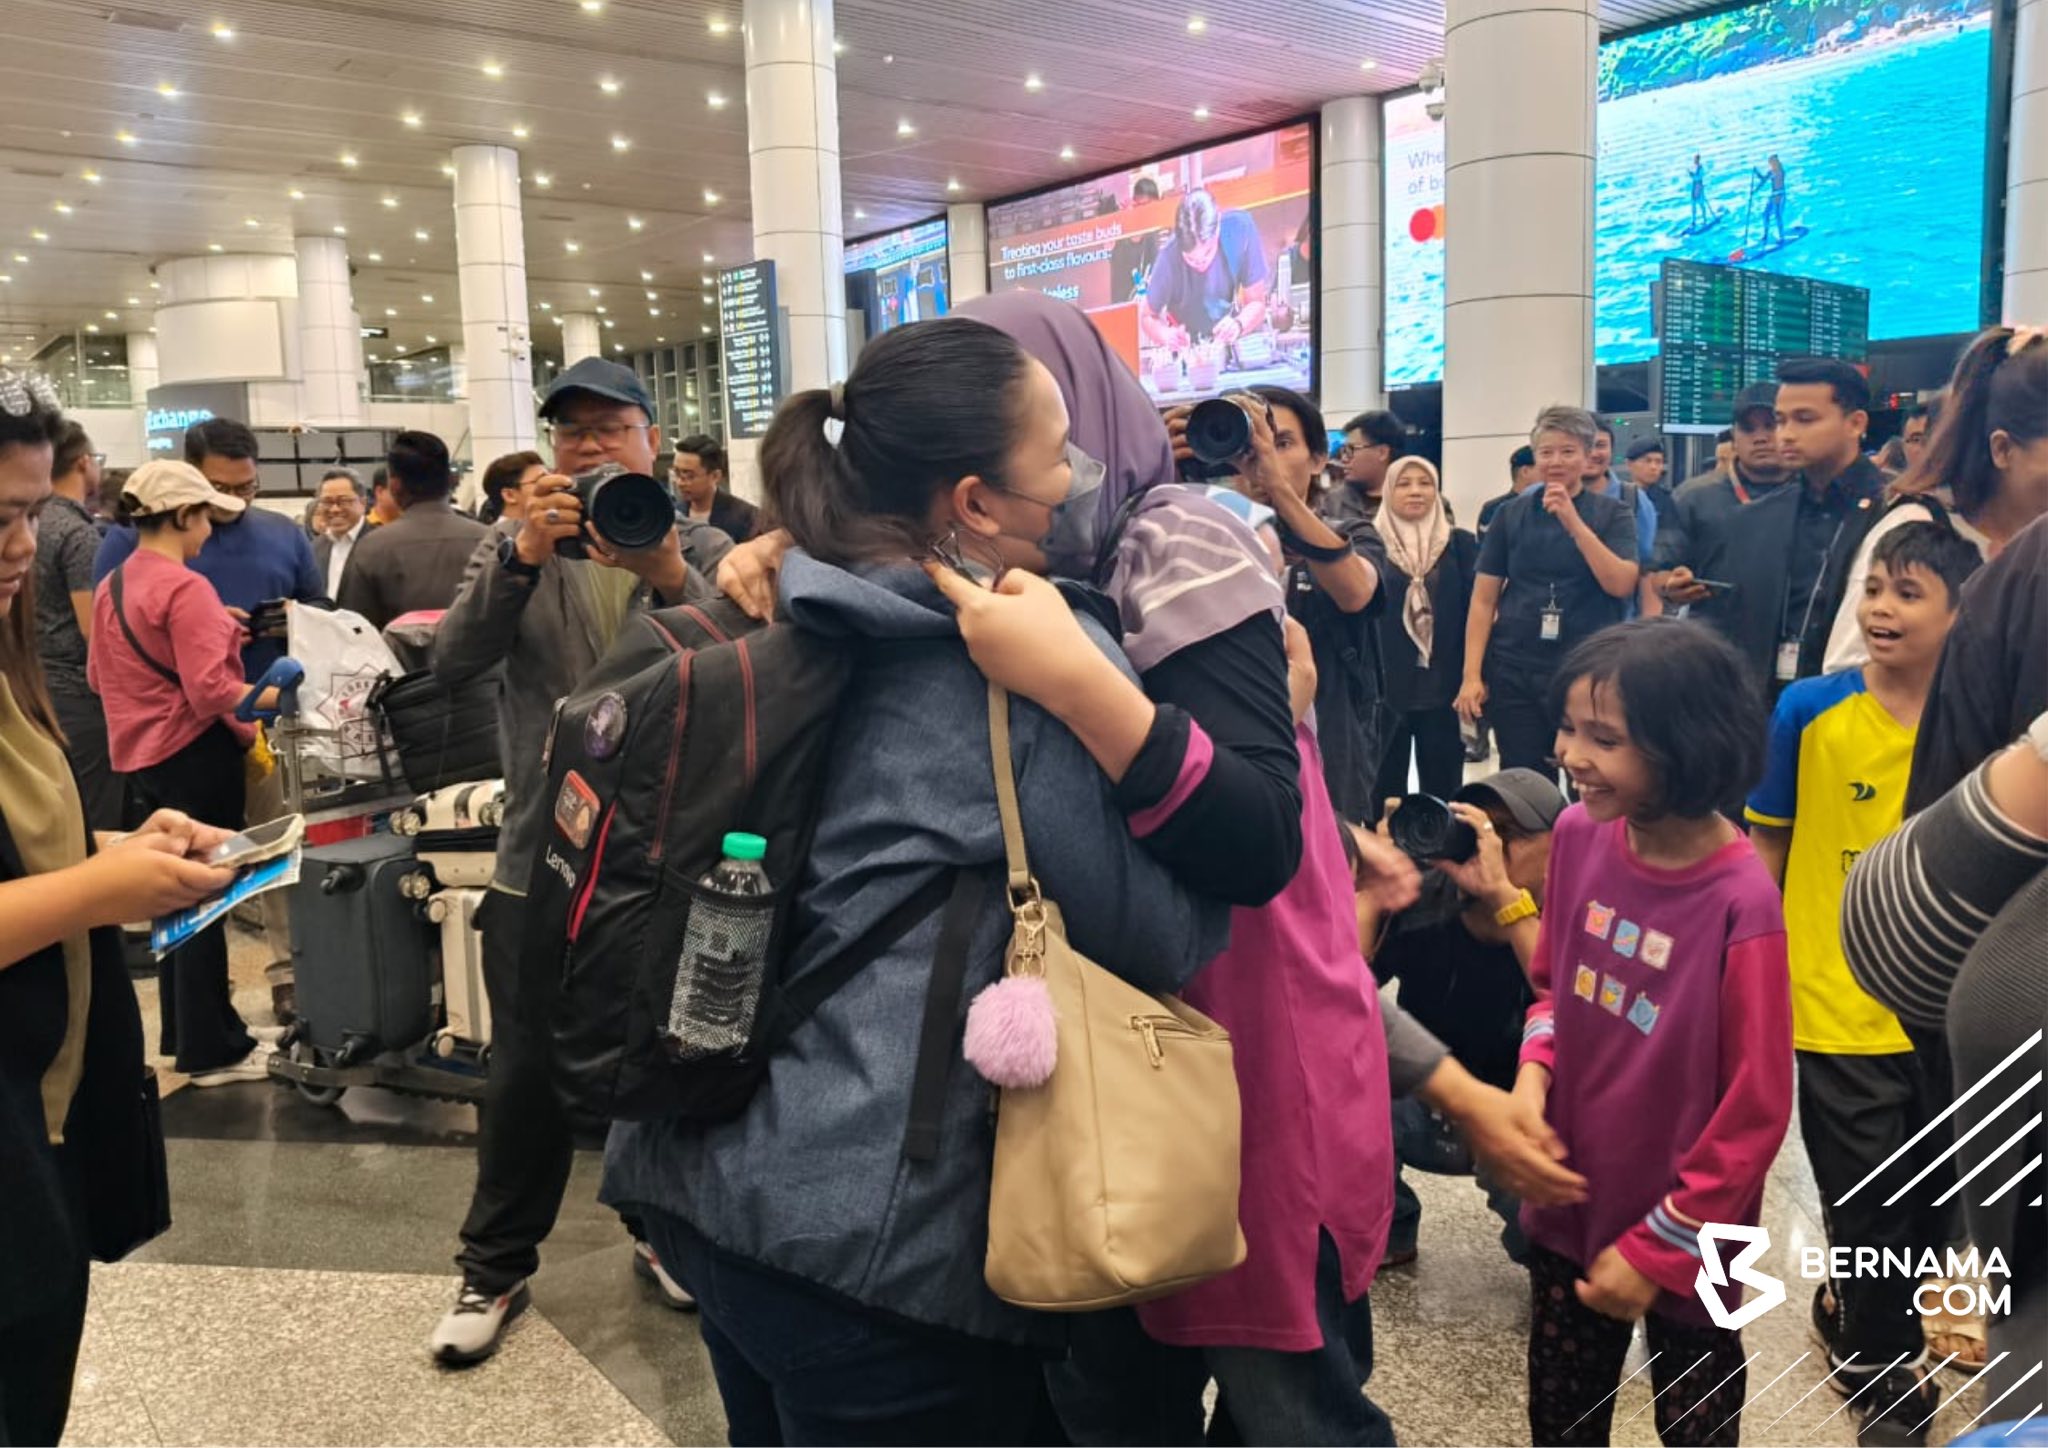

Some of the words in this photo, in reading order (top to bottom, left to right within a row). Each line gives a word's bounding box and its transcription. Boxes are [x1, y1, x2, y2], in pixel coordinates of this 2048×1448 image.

[1001, 242, 1040, 260] Treating
[1041, 237, 1064, 257] your
[1066, 232, 1092, 247] taste
[1095, 221, 1121, 241] buds
[1004, 266, 1016, 280] to
[1017, 256, 1064, 277] first-class
[546, 844, 576, 888] Lenovo
